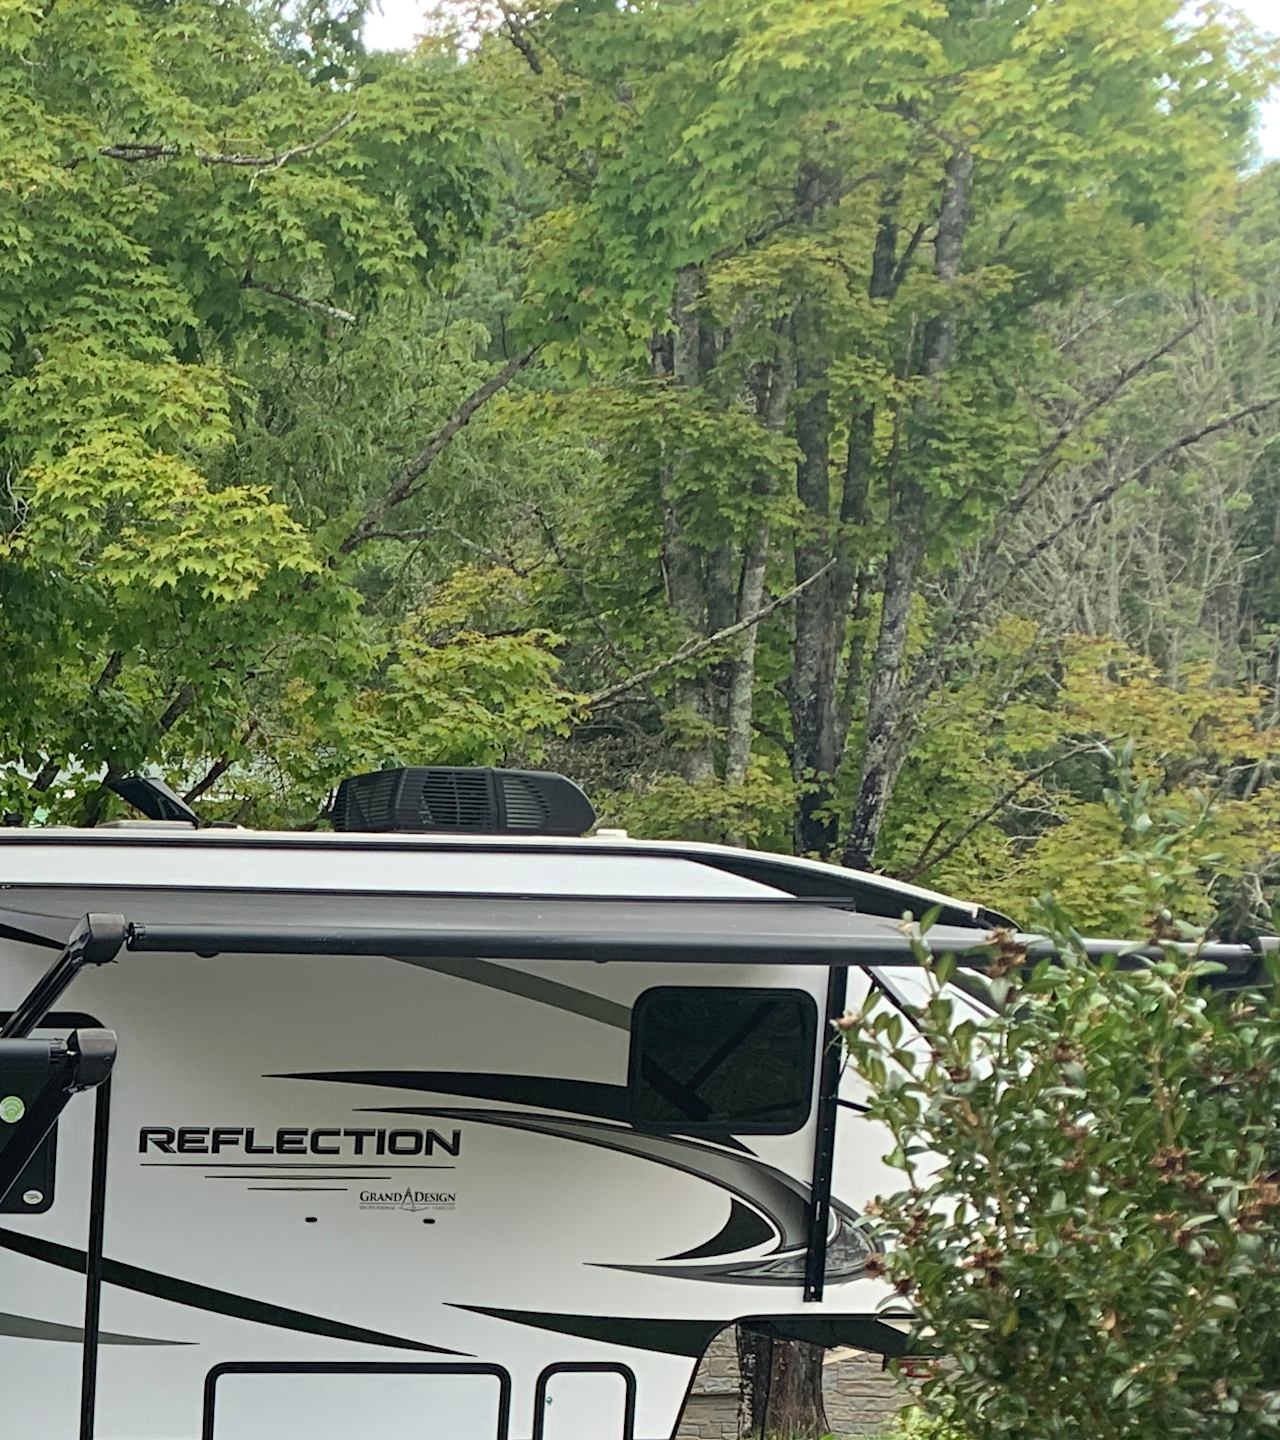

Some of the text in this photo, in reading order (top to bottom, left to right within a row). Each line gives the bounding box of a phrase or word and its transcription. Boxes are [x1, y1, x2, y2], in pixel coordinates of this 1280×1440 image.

[139, 1126, 461, 1156] REFLECTION
[359, 1190, 456, 1203] GRAND DESIGN
